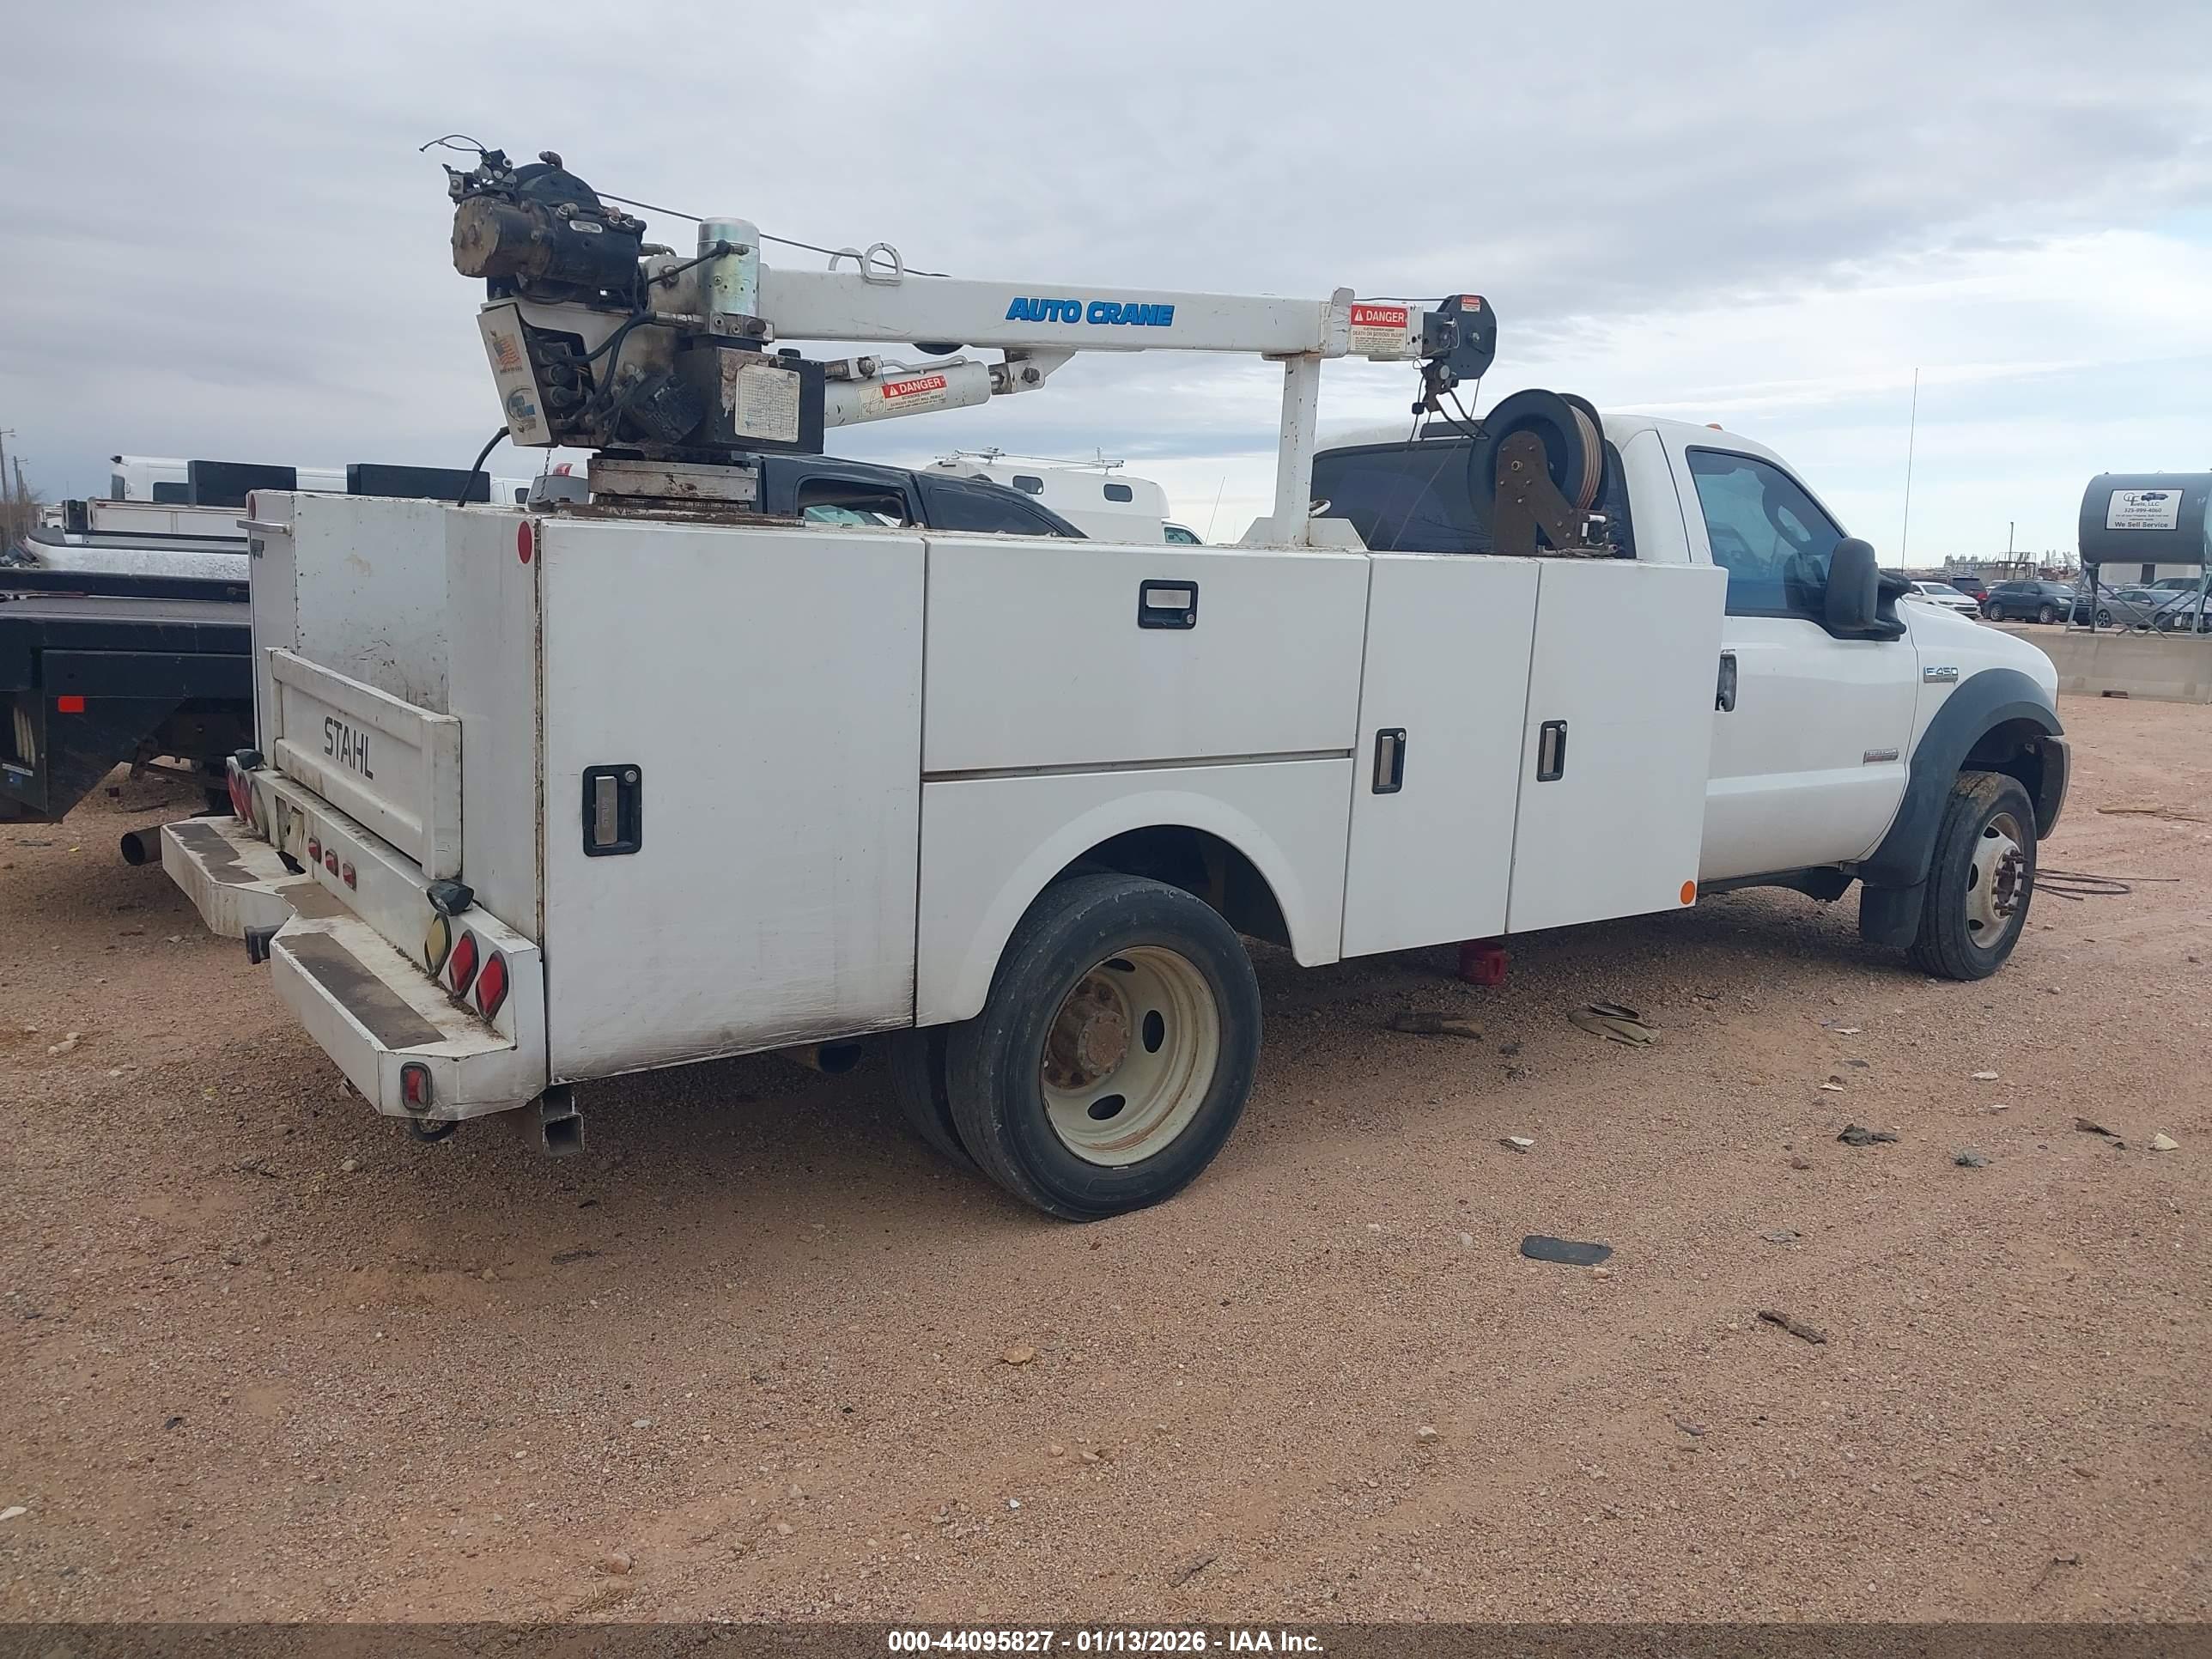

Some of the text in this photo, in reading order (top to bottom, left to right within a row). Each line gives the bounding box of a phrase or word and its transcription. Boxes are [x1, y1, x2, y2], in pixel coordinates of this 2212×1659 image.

[1006, 298, 1175, 326] AUTO CRANE
[1366, 311, 1405, 323] DANGER
[899, 378, 942, 393] DANGER
[324, 716, 374, 780] STAHL
